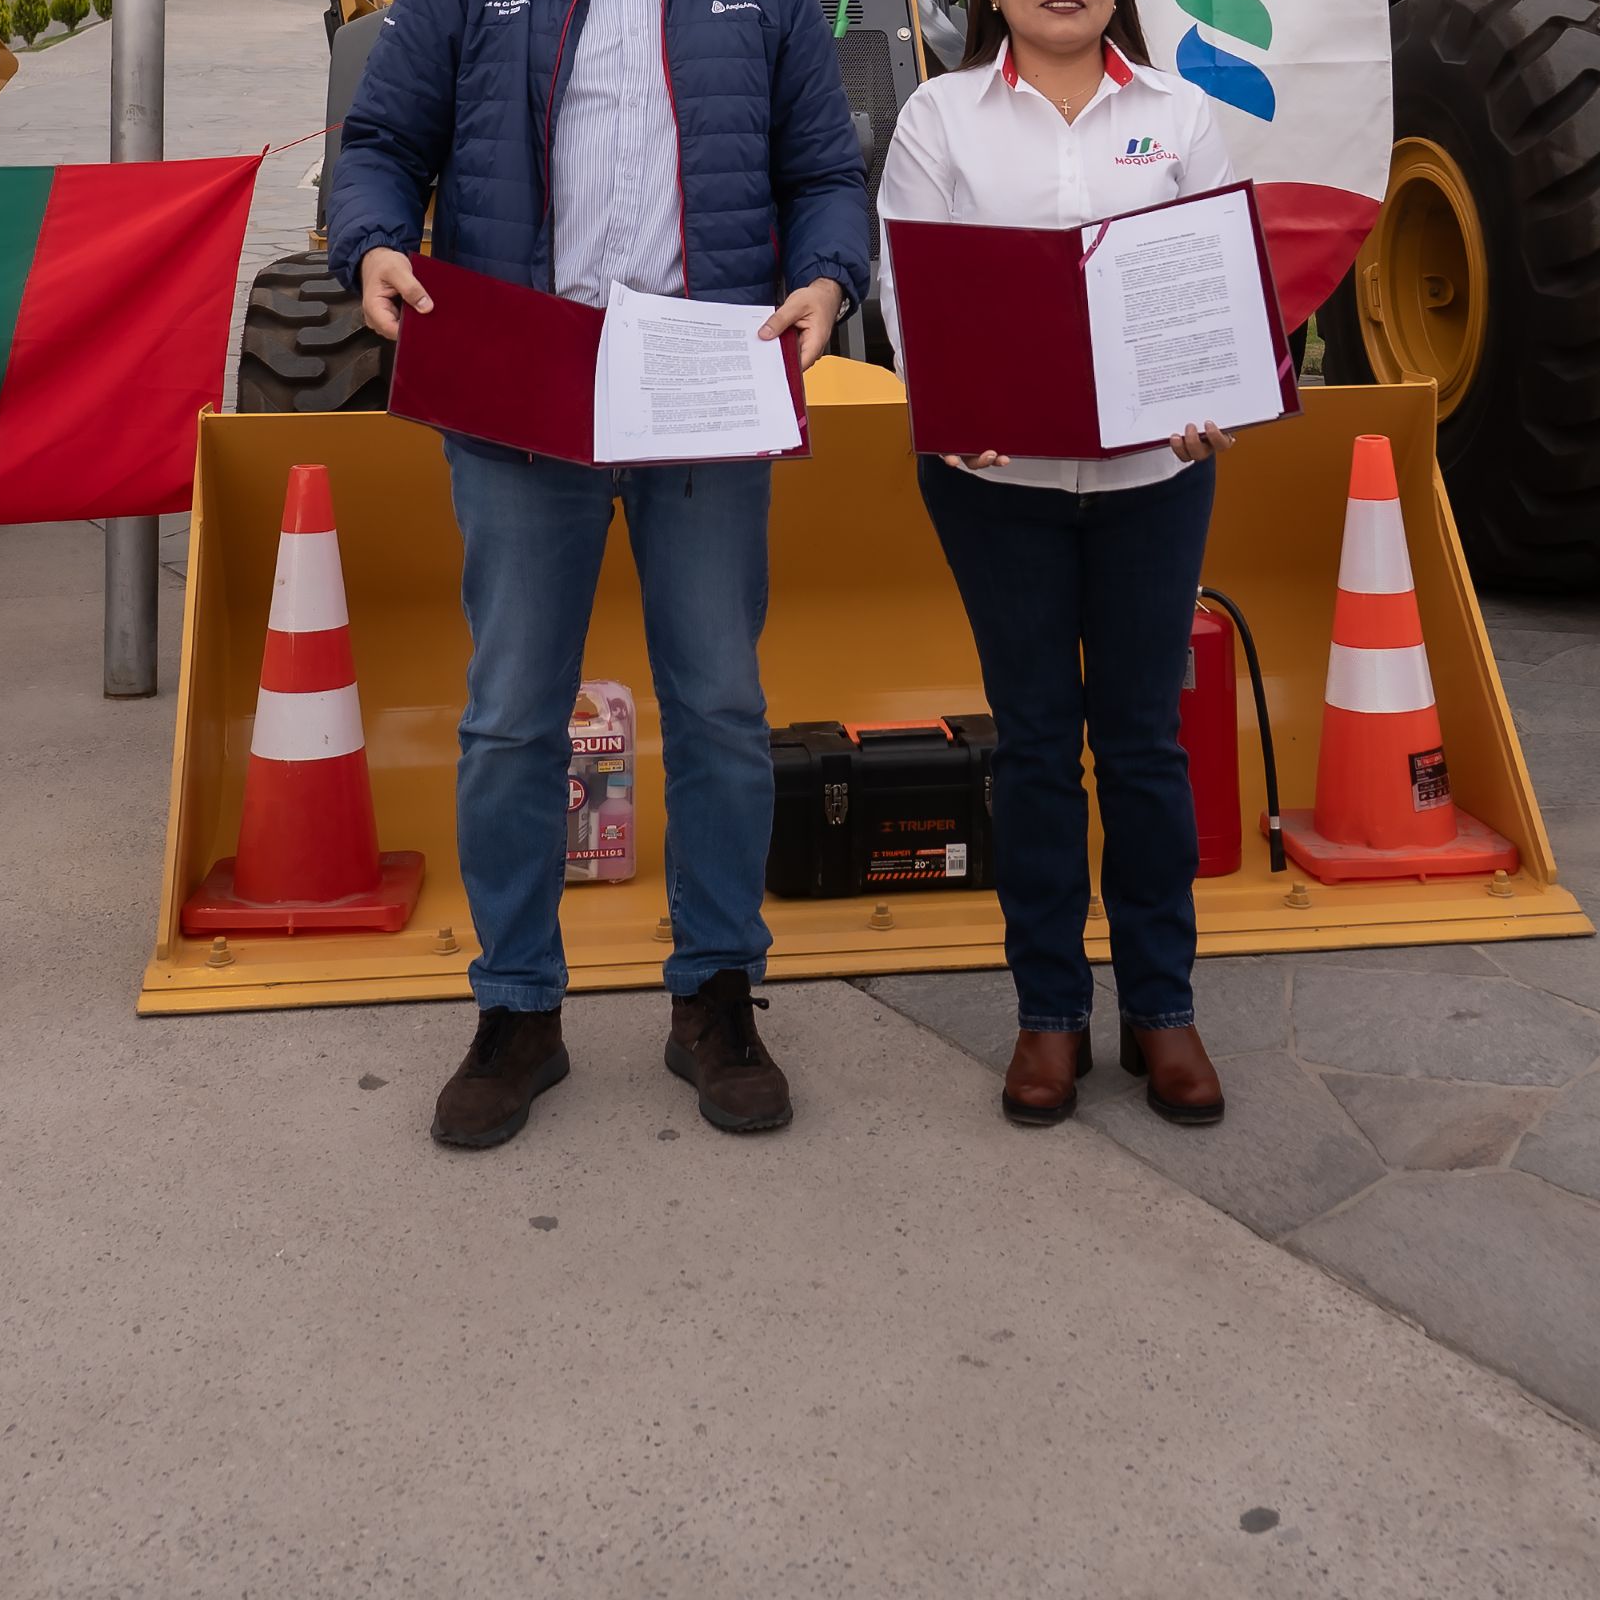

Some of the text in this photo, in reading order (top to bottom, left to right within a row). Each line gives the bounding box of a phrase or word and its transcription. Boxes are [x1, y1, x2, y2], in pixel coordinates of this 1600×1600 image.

[1115, 152, 1180, 165] MOQUEGUA
[898, 819, 956, 831] TRUPER
[576, 848, 623, 859] AUXILIOS
